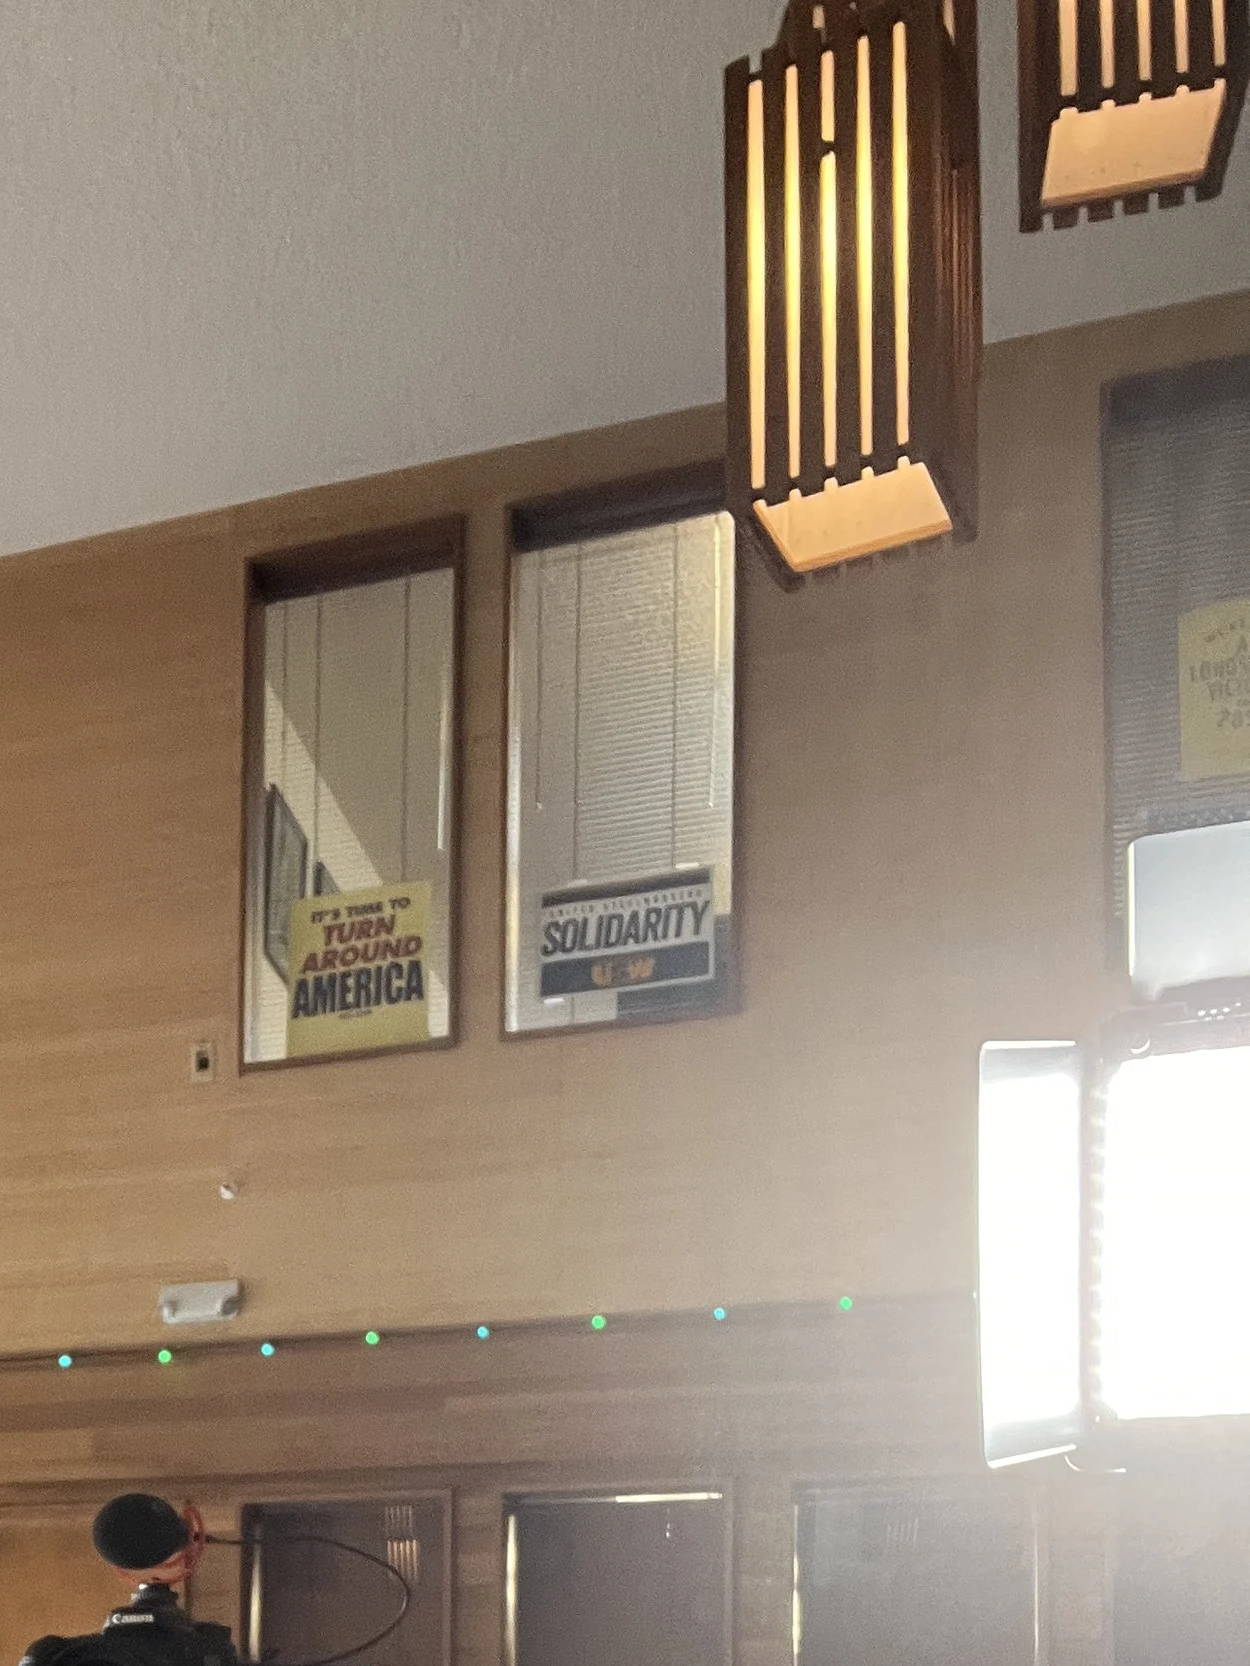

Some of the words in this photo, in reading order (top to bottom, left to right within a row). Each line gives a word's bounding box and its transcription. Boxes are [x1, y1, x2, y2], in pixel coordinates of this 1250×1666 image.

[311, 908, 341, 924] IT'S
[388, 896, 412, 910] TO
[541, 899, 711, 957] SOLIDARITY
[323, 914, 396, 947] TURN
[299, 935, 424, 975] AROUND
[291, 959, 425, 1020] AMERICA
[112, 1613, 155, 1625] Canon
